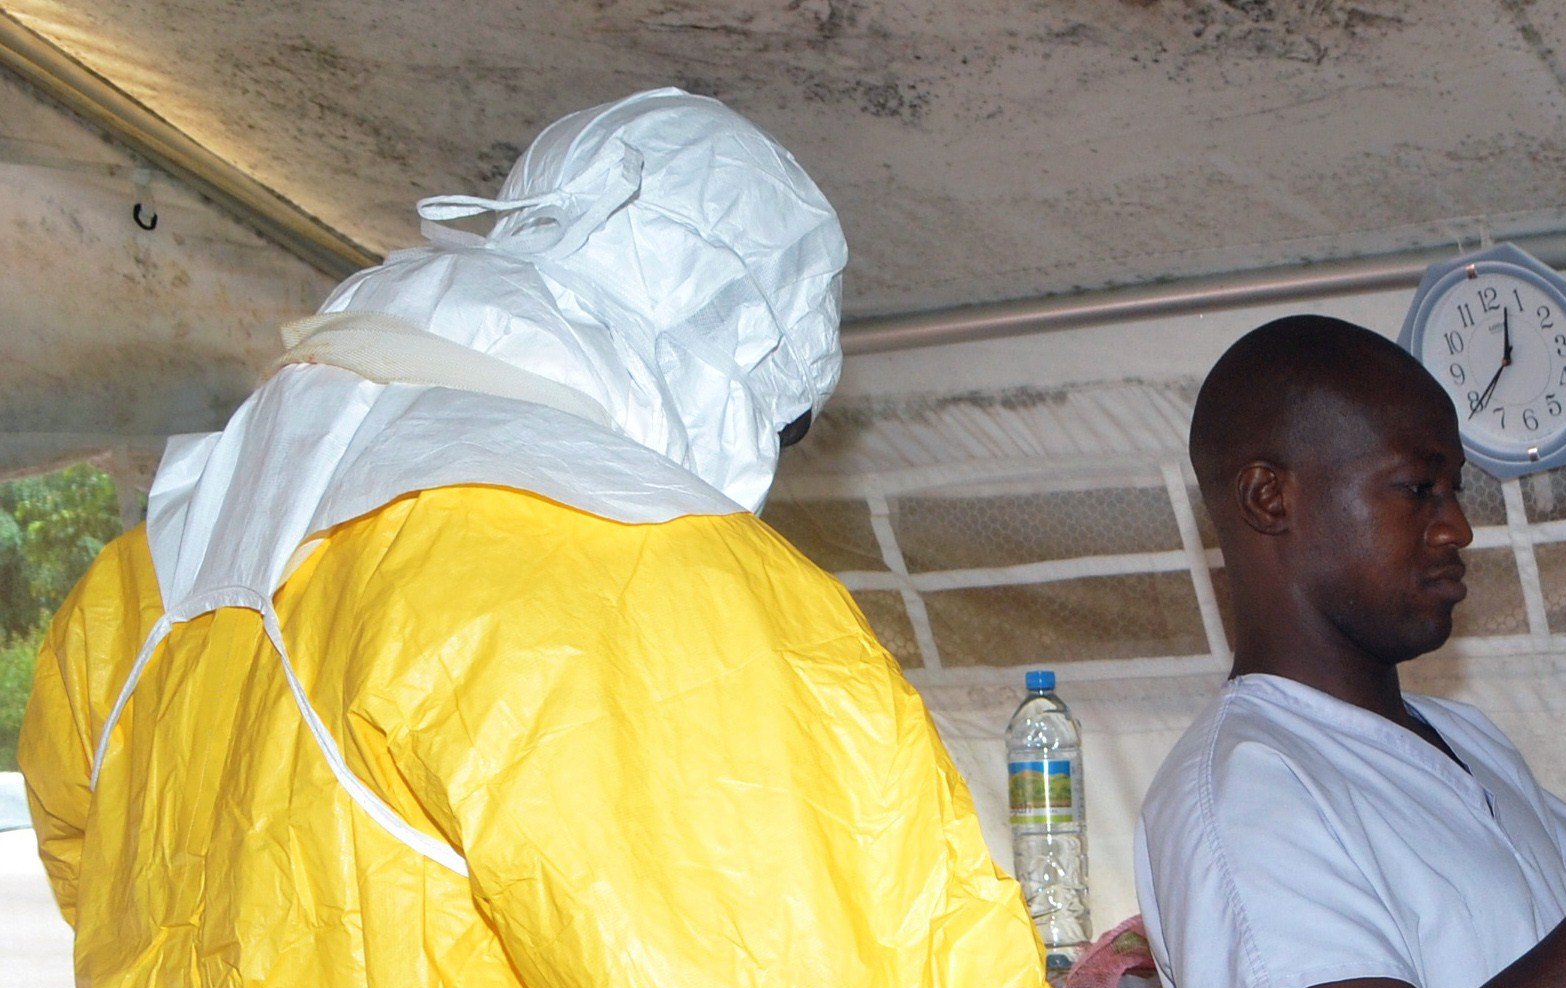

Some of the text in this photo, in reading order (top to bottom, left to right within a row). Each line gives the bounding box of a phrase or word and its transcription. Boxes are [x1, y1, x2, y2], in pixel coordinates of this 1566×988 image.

[1478, 287, 1500, 313] 12
[1513, 289, 1524, 312] 1
[1457, 303, 1475, 328] 11
[1536, 305, 1554, 329] 2
[1444, 330, 1464, 355] 10
[1449, 363, 1466, 386] 9
[1467, 391, 1484, 414] 8
[1545, 393, 1562, 416] 5
[1493, 407, 1506, 430] 7
[1522, 408, 1539, 431] 6
